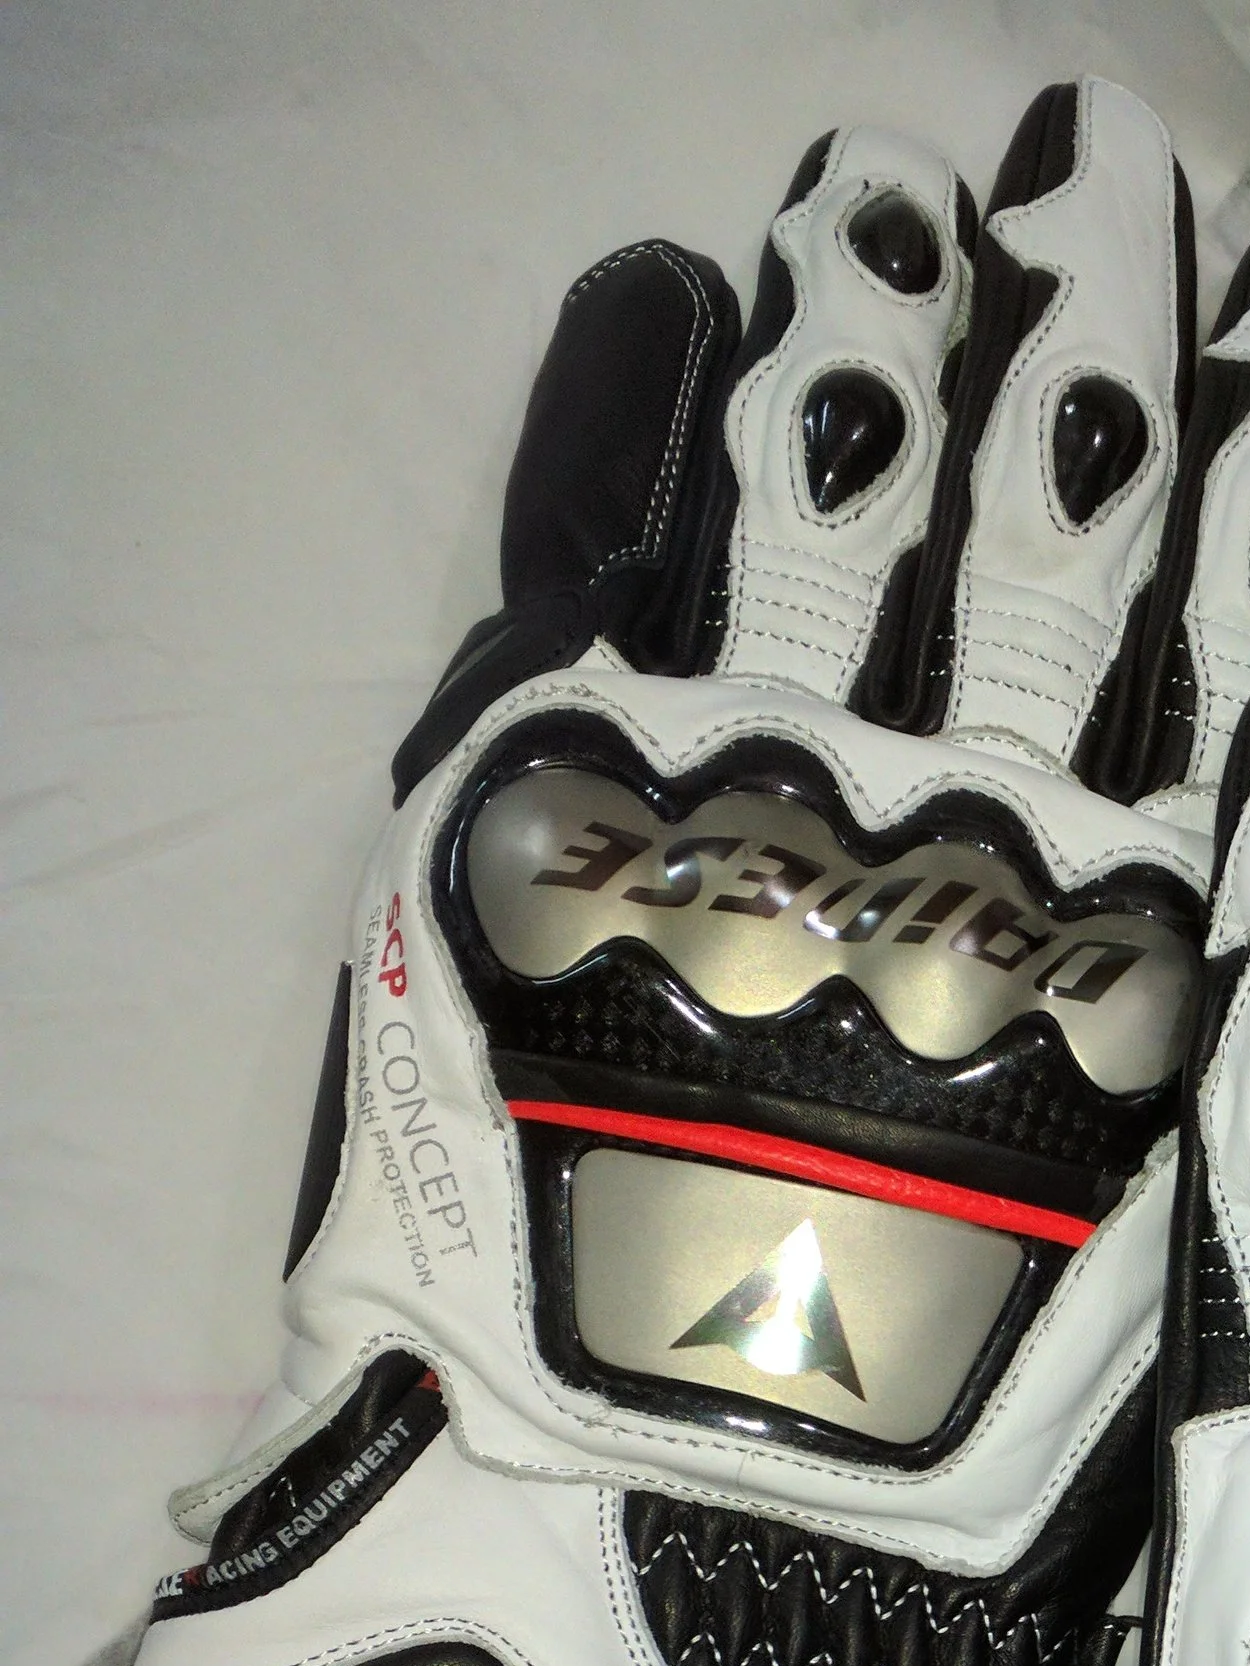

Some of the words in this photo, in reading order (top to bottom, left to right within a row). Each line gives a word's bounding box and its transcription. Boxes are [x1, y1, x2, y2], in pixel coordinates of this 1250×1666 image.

[378, 891, 408, 998] SCP
[356, 1039, 379, 1126] CRASH
[369, 1128, 436, 1289] PROTECTION
[376, 1020, 478, 1260] CONCEPT
[276, 1416, 412, 1550] EQUIPMENT
